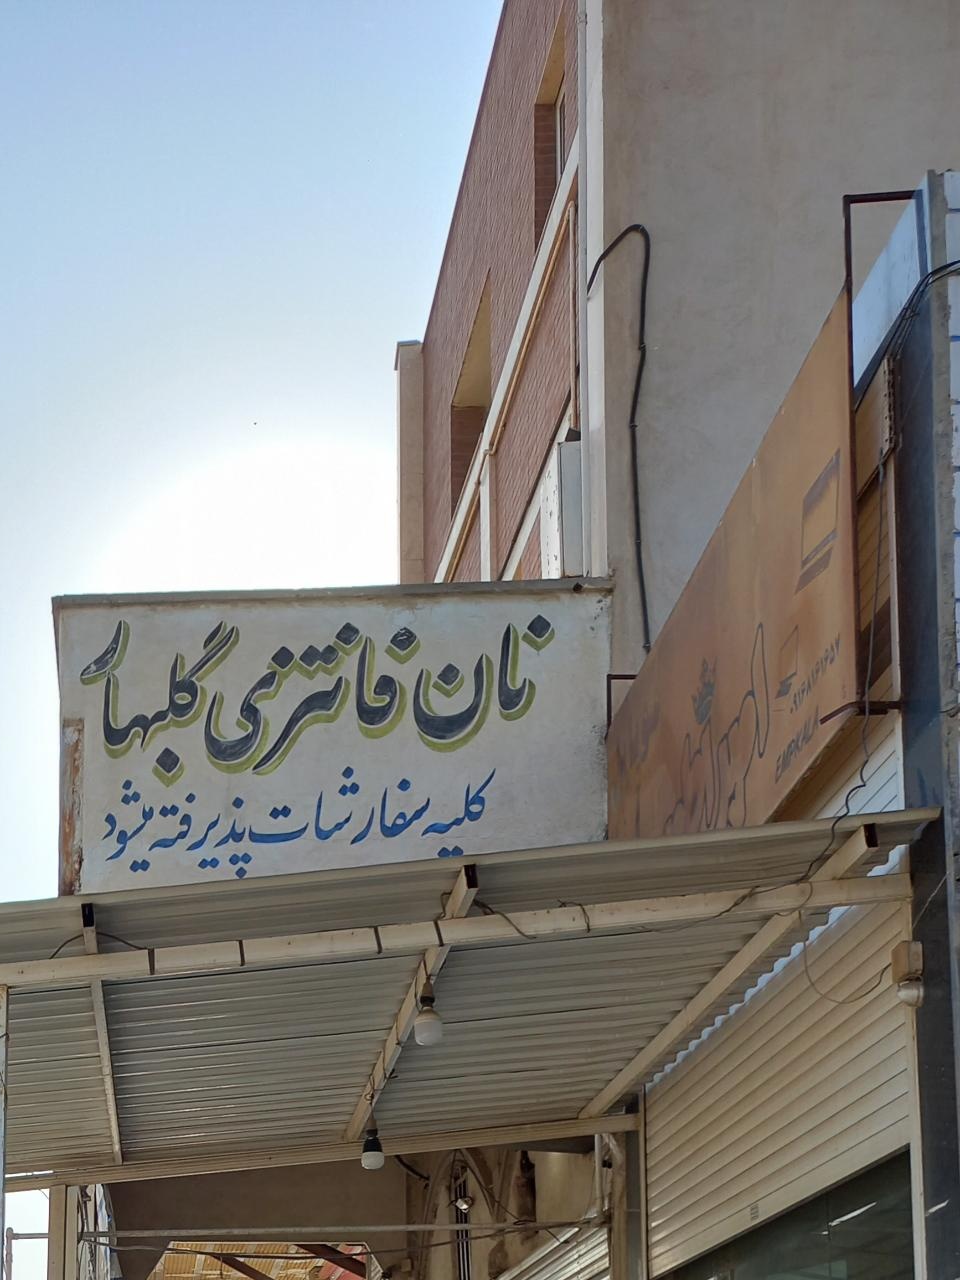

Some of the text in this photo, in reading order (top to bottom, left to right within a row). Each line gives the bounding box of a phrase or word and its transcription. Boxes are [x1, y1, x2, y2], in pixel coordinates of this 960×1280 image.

[204, 621, 422, 776] فانتزی
[413, 614, 555, 753] نان
[148, 793, 251, 879] پذیرفته
[248, 767, 431, 845] سفارشات
[420, 768, 497, 858] کلیه
